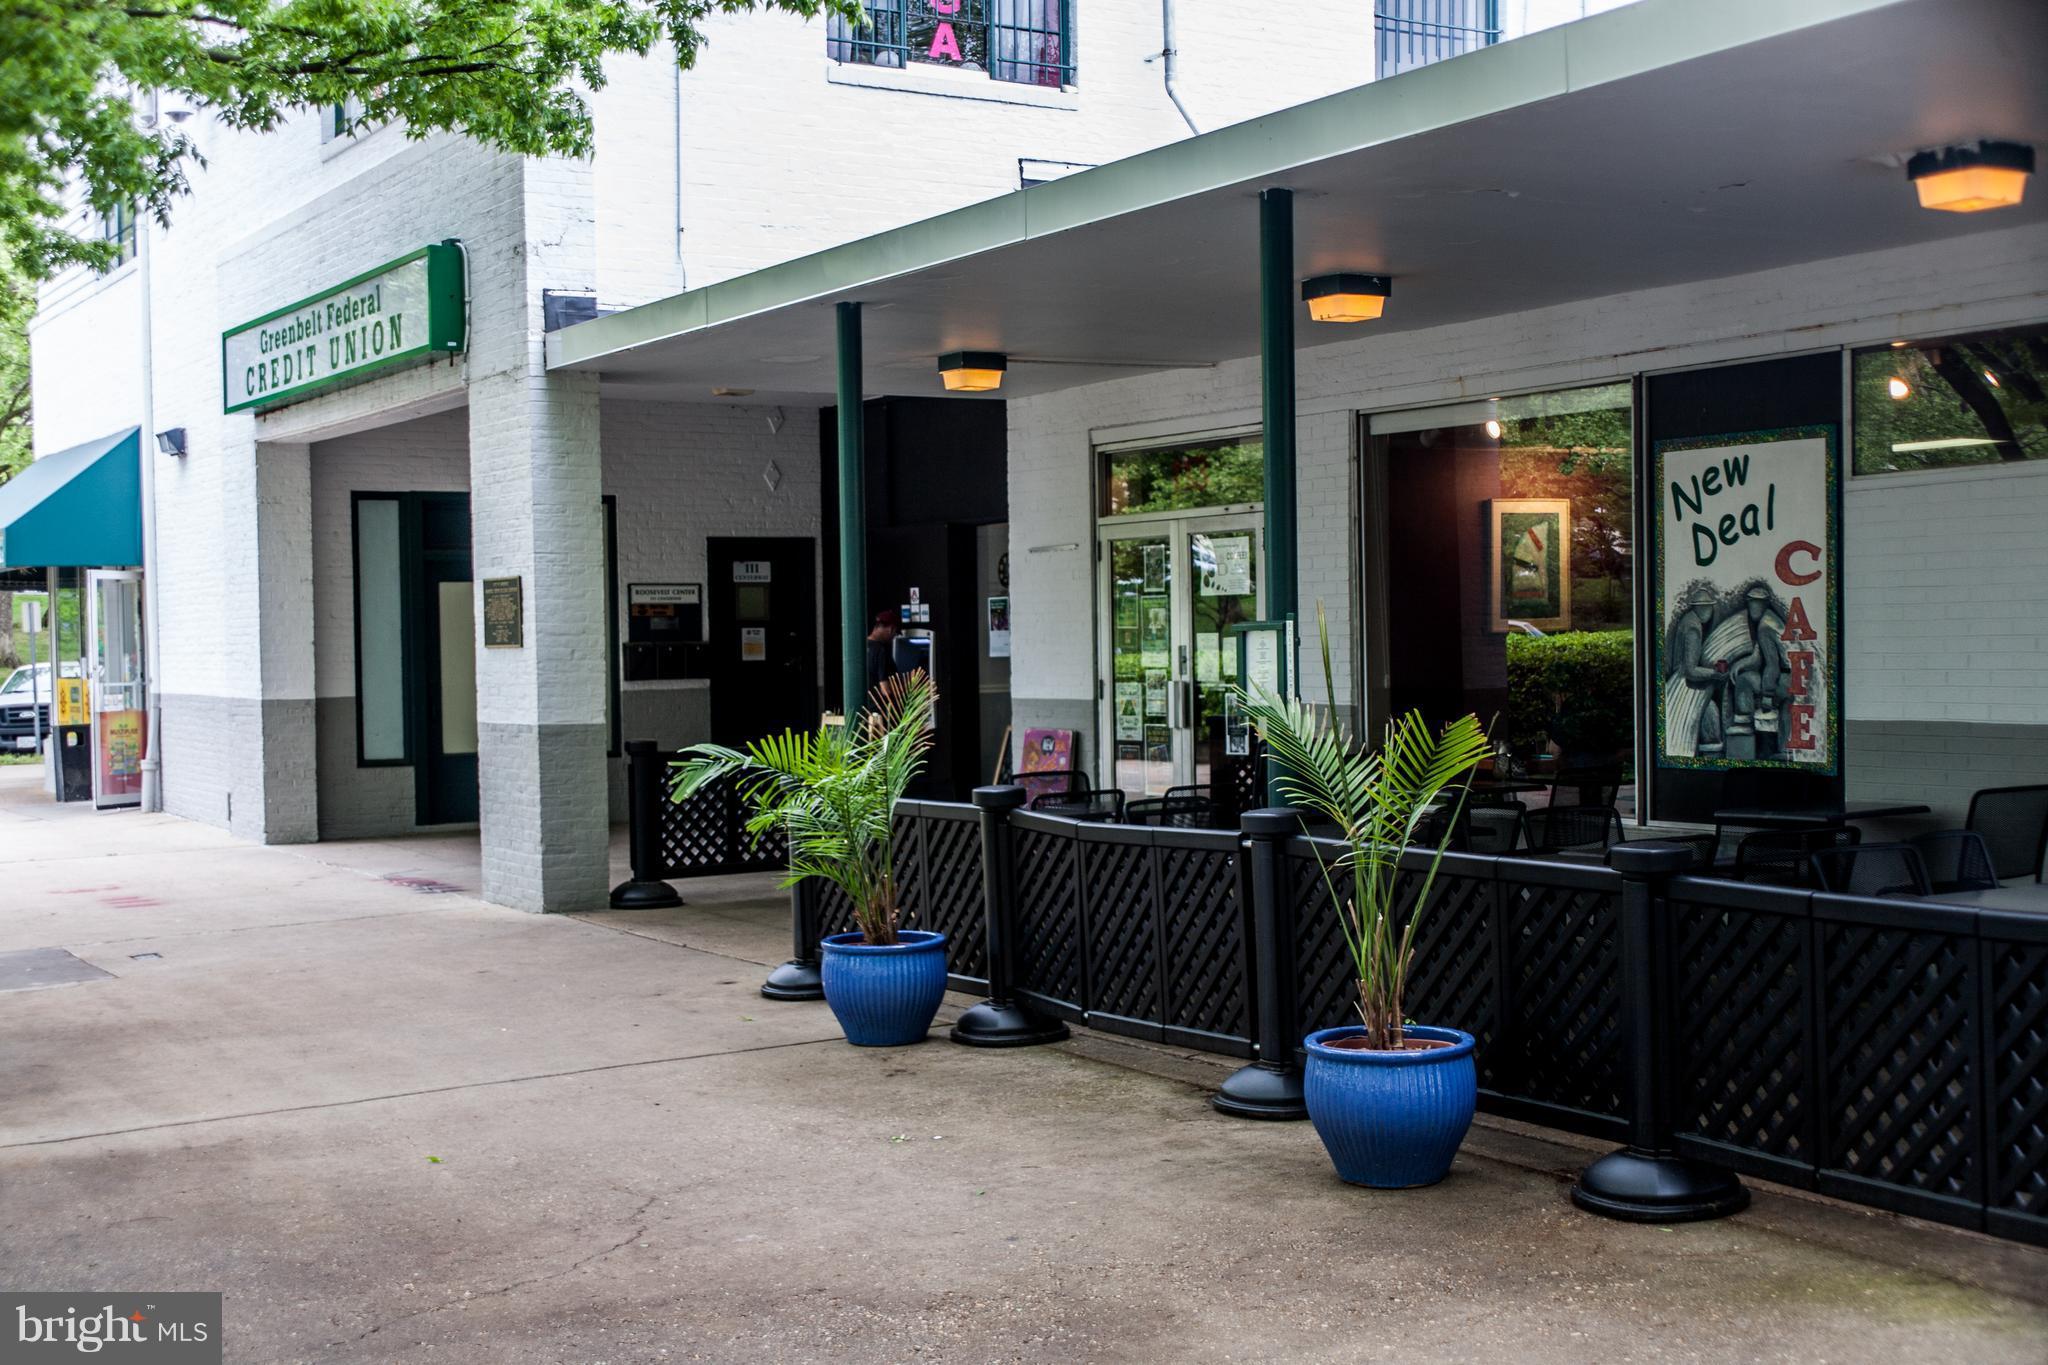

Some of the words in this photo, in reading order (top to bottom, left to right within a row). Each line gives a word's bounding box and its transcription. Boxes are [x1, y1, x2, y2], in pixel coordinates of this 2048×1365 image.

[246, 344, 316, 396] CREDIT
[330, 313, 402, 369] UNION
[260, 310, 322, 355] Greenbelt
[327, 284, 382, 331] Federal
[1670, 454, 1750, 522] New
[1691, 483, 1775, 567] Deal
[1774, 540, 1823, 750] CAFE
